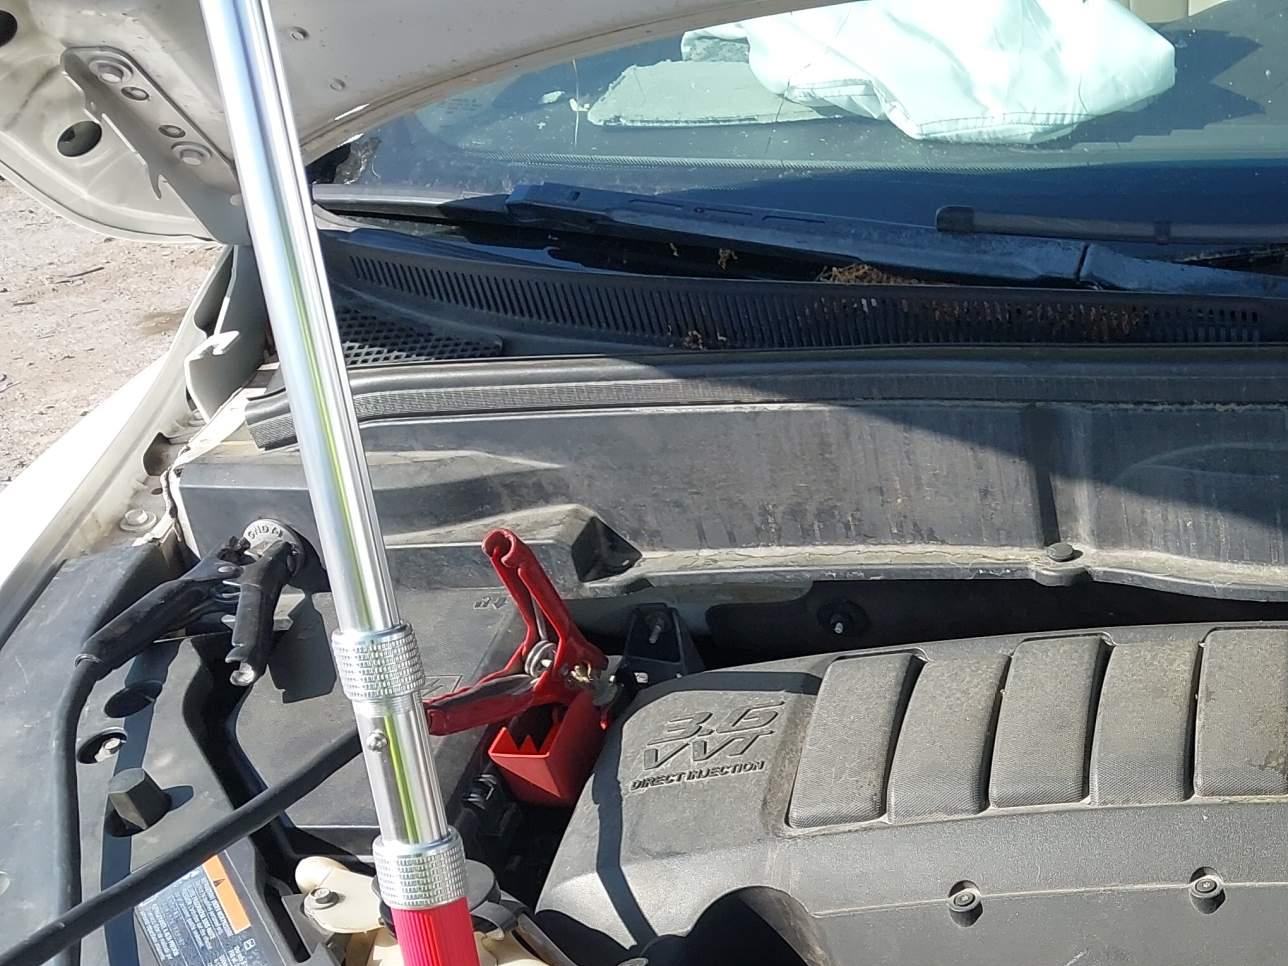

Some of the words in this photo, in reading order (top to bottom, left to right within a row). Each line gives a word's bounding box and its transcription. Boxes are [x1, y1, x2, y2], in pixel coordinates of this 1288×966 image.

[646, 700, 785, 746] 3.6
[643, 729, 776, 771] VVT
[630, 772, 685, 791] DIRECT
[686, 760, 766, 782] INJECTION
